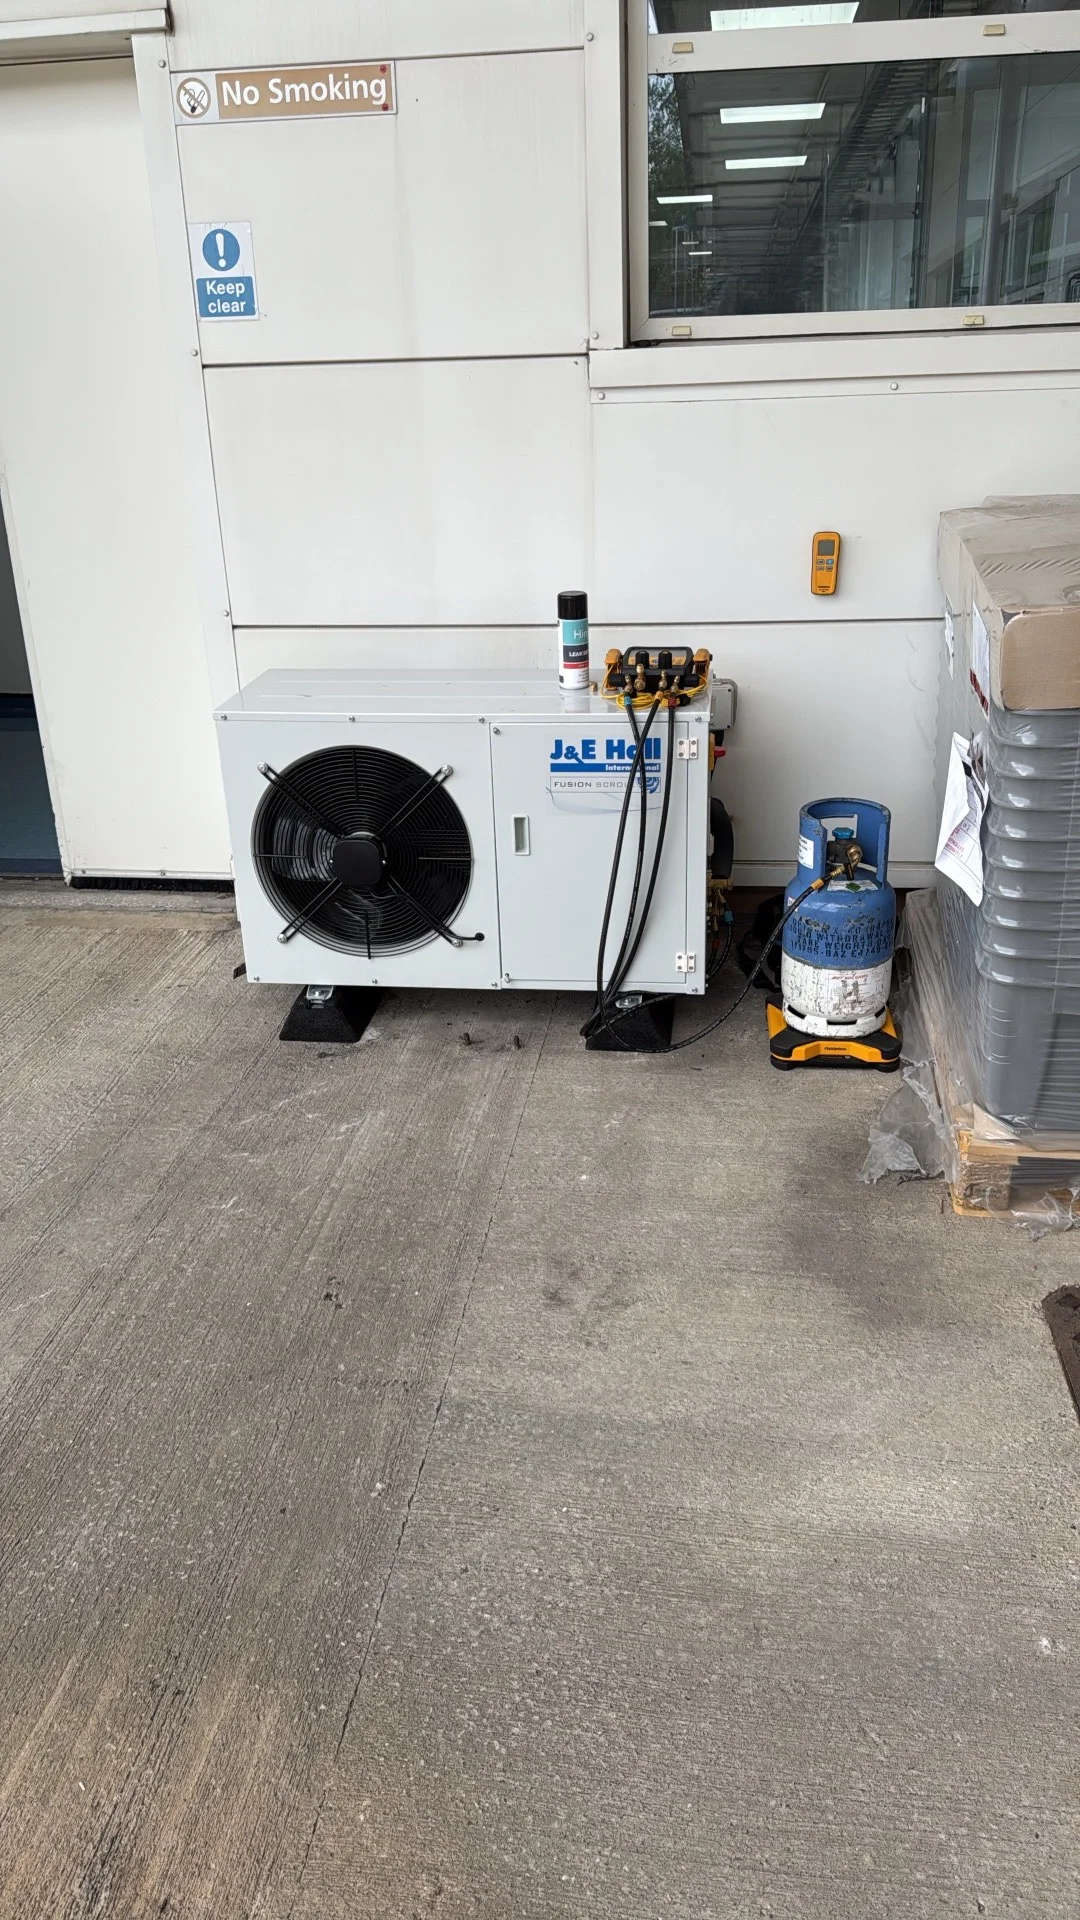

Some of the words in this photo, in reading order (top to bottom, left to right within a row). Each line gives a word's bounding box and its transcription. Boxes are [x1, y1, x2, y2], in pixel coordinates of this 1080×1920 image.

[222, 80, 260, 106] No
[268, 72, 387, 105] Smoking
[206, 280, 245, 297] Keep
[208, 298, 246, 313] clear
[550, 739, 596, 760] J&E
[797, 935, 819, 948] TARE
